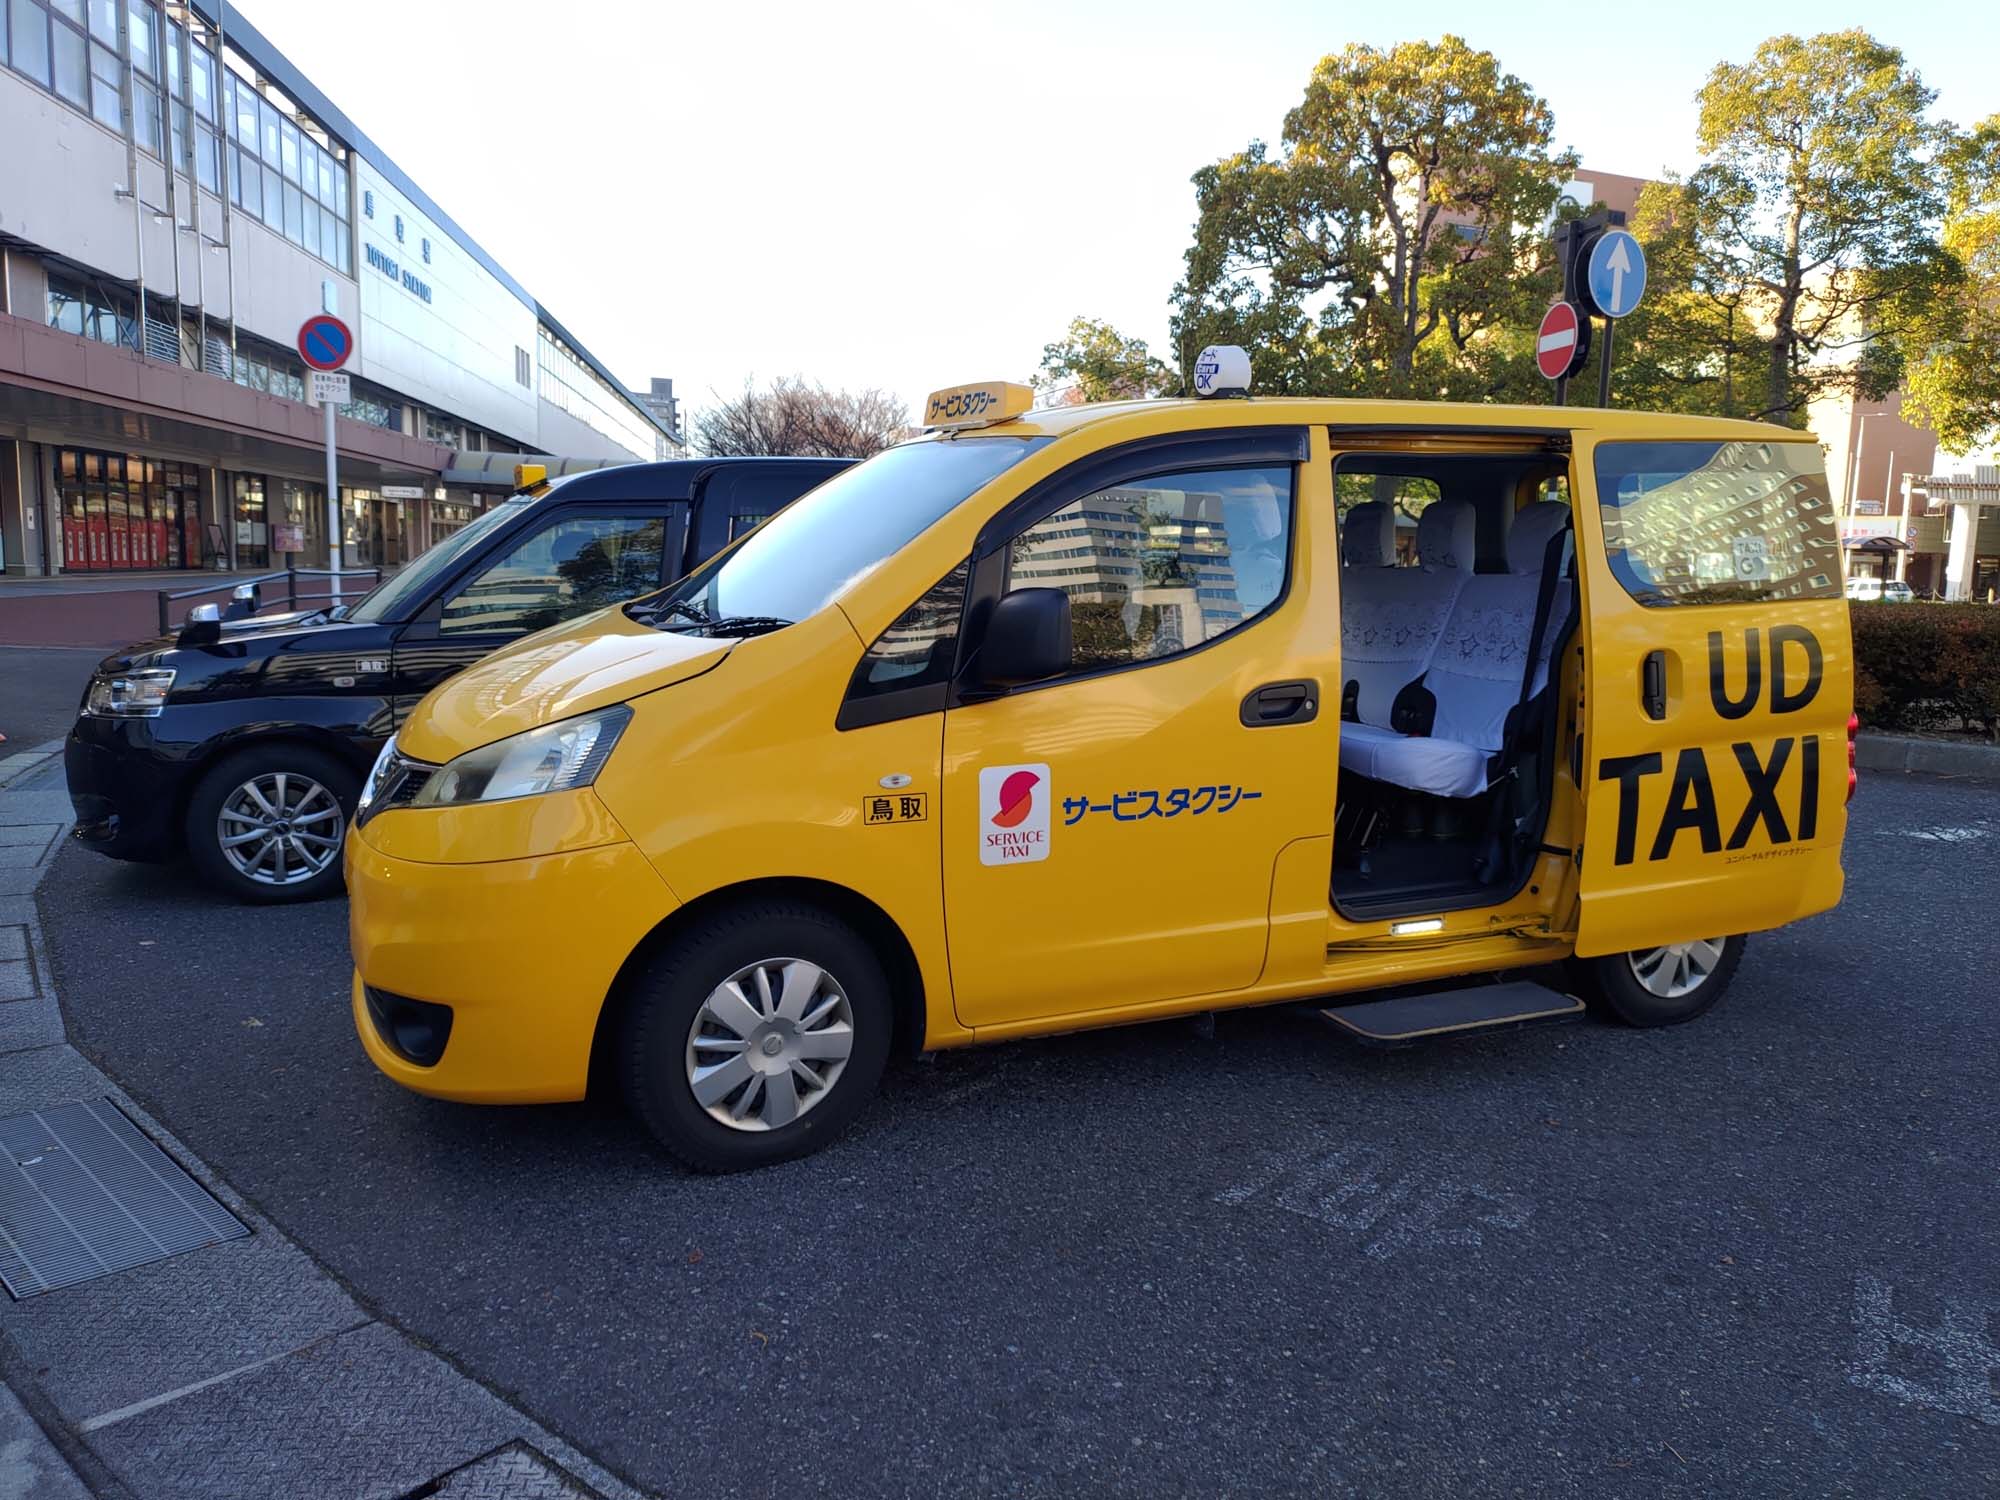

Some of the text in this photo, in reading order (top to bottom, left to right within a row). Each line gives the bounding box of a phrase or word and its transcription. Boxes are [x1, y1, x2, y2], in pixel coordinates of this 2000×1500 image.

[365, 242, 432, 305] TOTTORI STATION
[1196, 374, 1212, 389] OK
[931, 391, 997, 419] サービスタクシー
[1707, 624, 1823, 720] UD
[870, 796, 922, 821] 鳥取
[1063, 785, 1262, 826] サービスタクシー
[1598, 735, 1819, 866] TAXI
[986, 830, 1045, 848] SERVICE
[1001, 844, 1030, 859] TAXI
